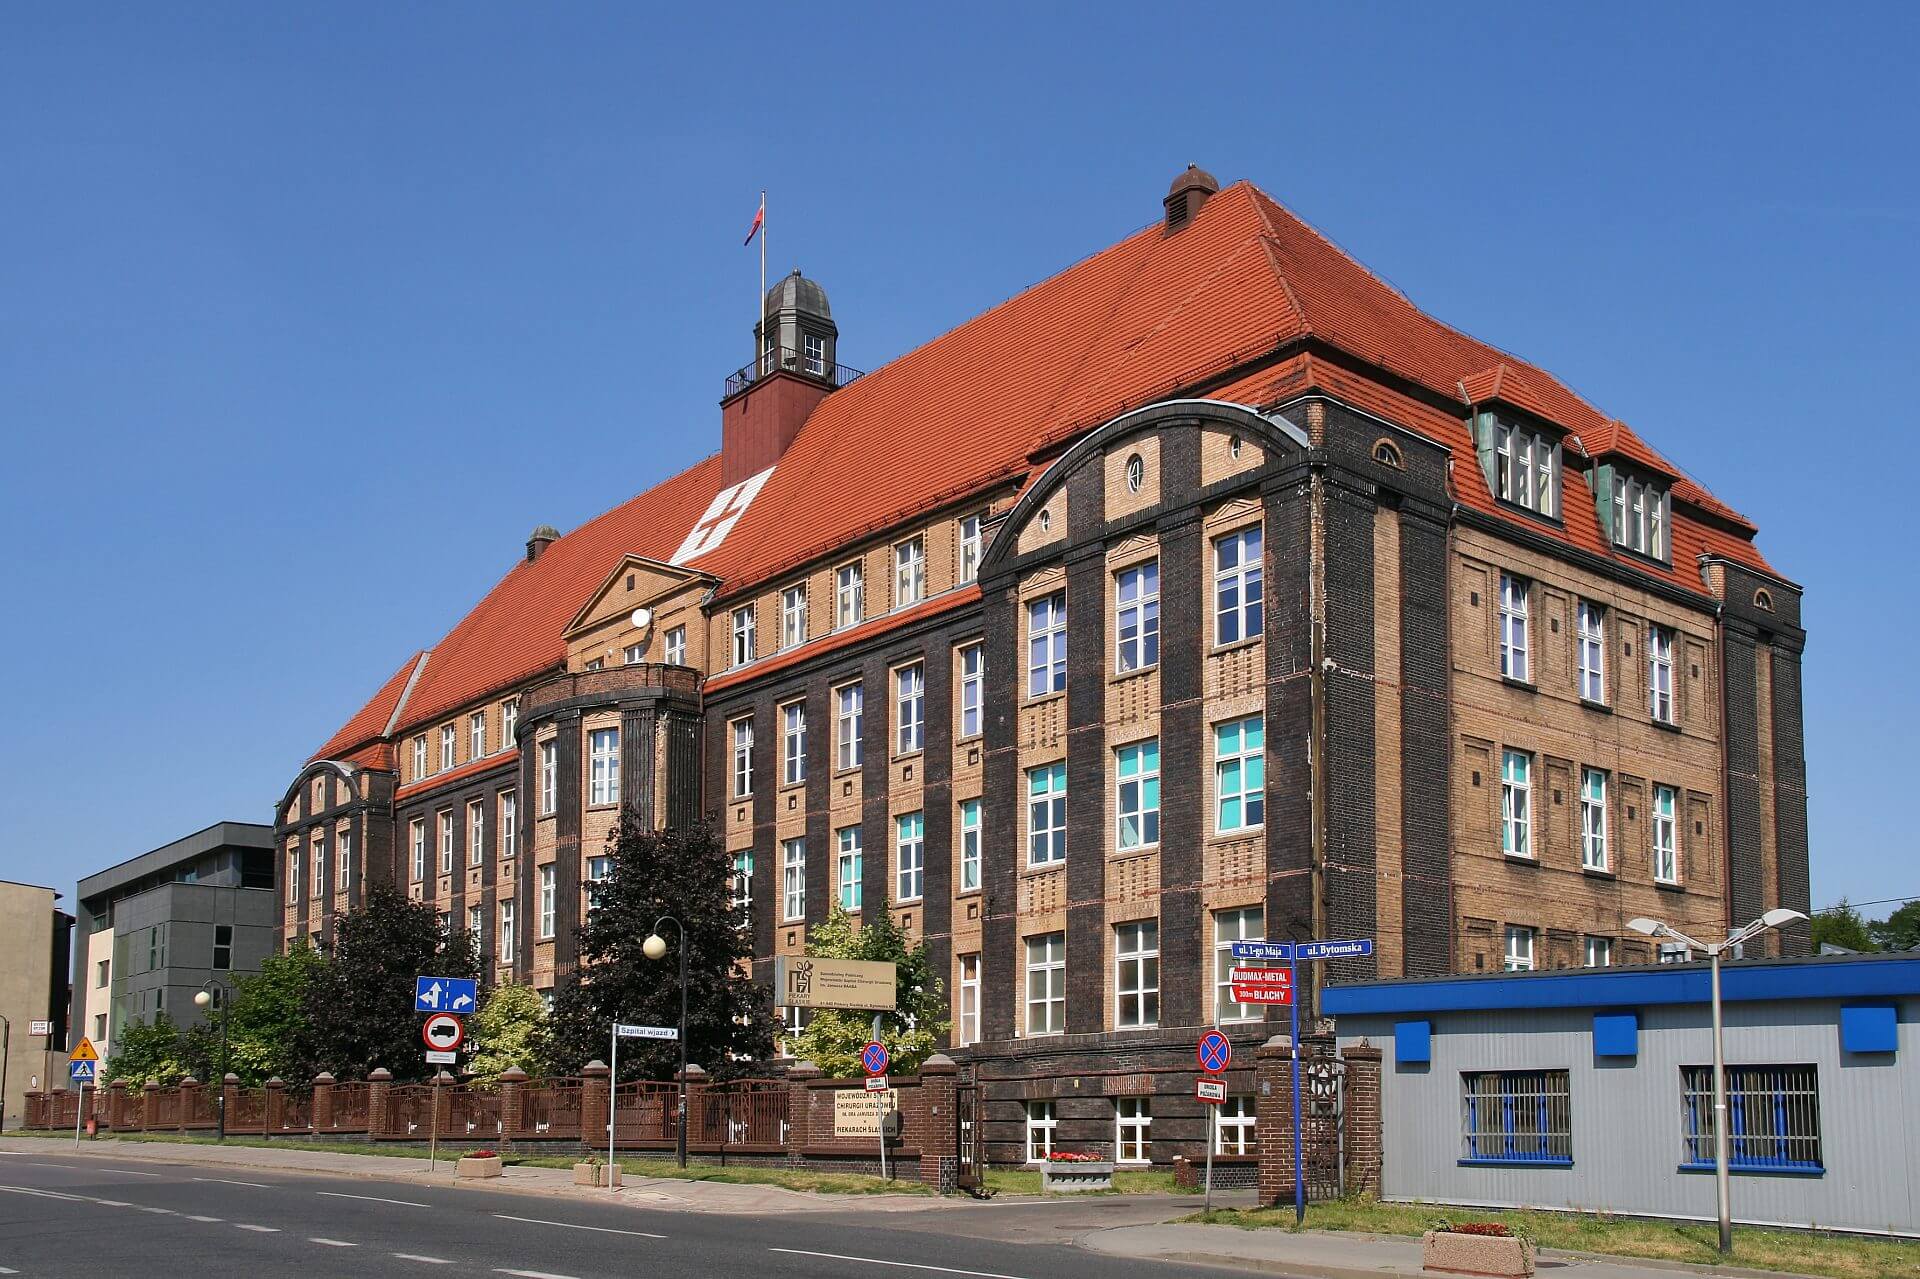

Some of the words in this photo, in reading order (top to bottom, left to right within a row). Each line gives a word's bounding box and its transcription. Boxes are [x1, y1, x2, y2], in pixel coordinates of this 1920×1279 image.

[1249, 946, 1264, 957] 1-go
[1265, 947, 1282, 958] Maja
[1307, 947, 1318, 955] ul.
[1320, 944, 1362, 957] Bytomska
[1234, 970, 1287, 982] BUDMAX-METAL
[1254, 990, 1285, 1000] BLACHY
[621, 1027, 646, 1035] Szpital
